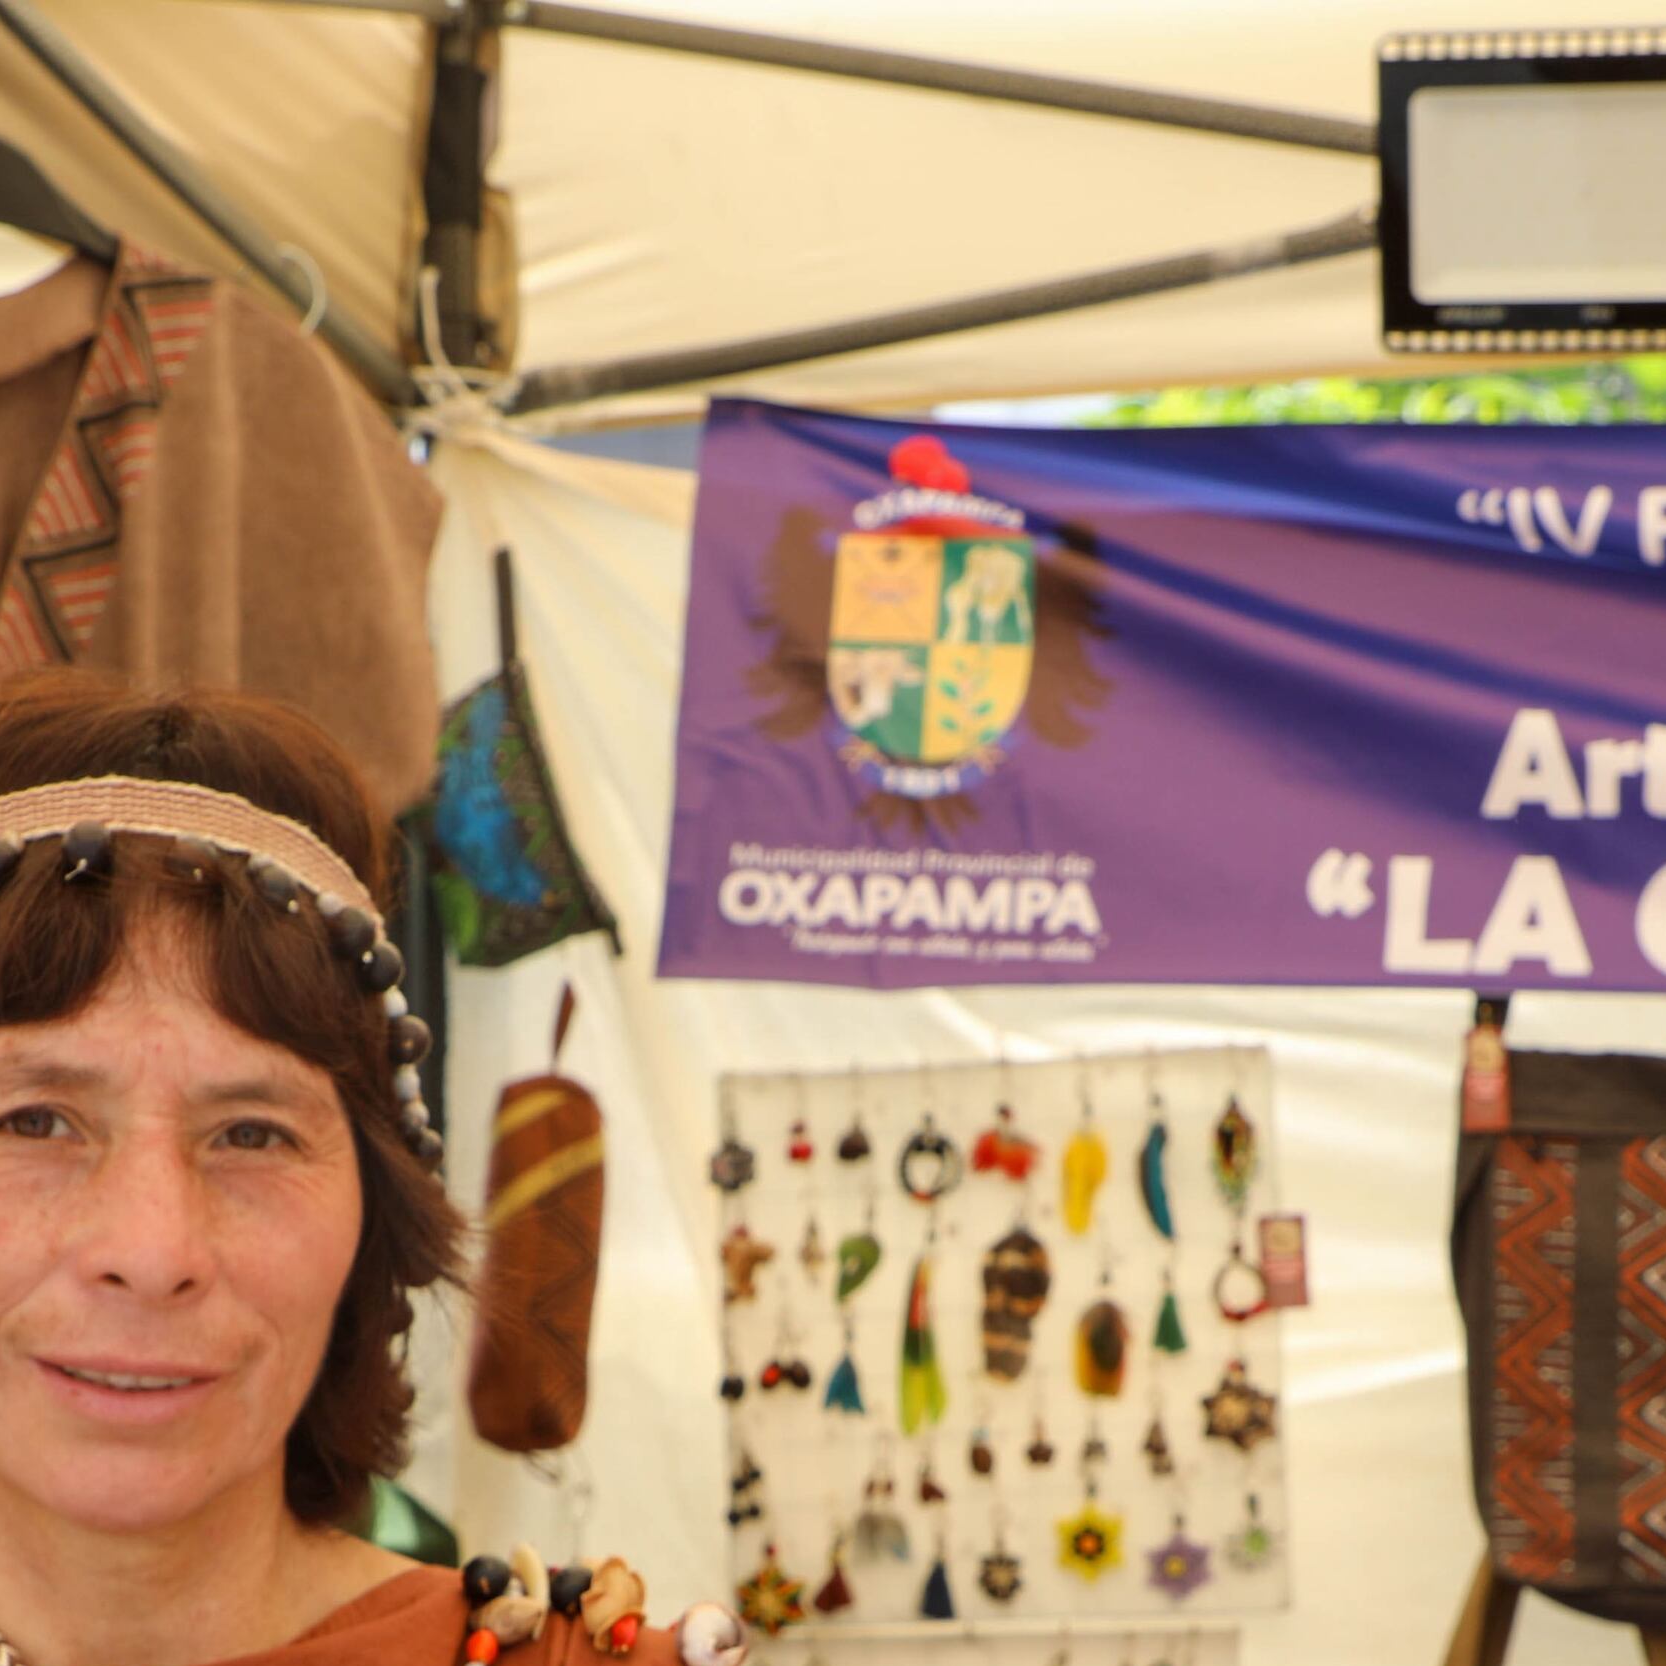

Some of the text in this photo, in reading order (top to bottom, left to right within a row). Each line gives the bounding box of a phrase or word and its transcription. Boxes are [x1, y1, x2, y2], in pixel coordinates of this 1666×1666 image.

[729, 842, 921, 875] Municipalidad
[922, 848, 1054, 879] Provincial
[718, 867, 1102, 936] OXAPAMPA
